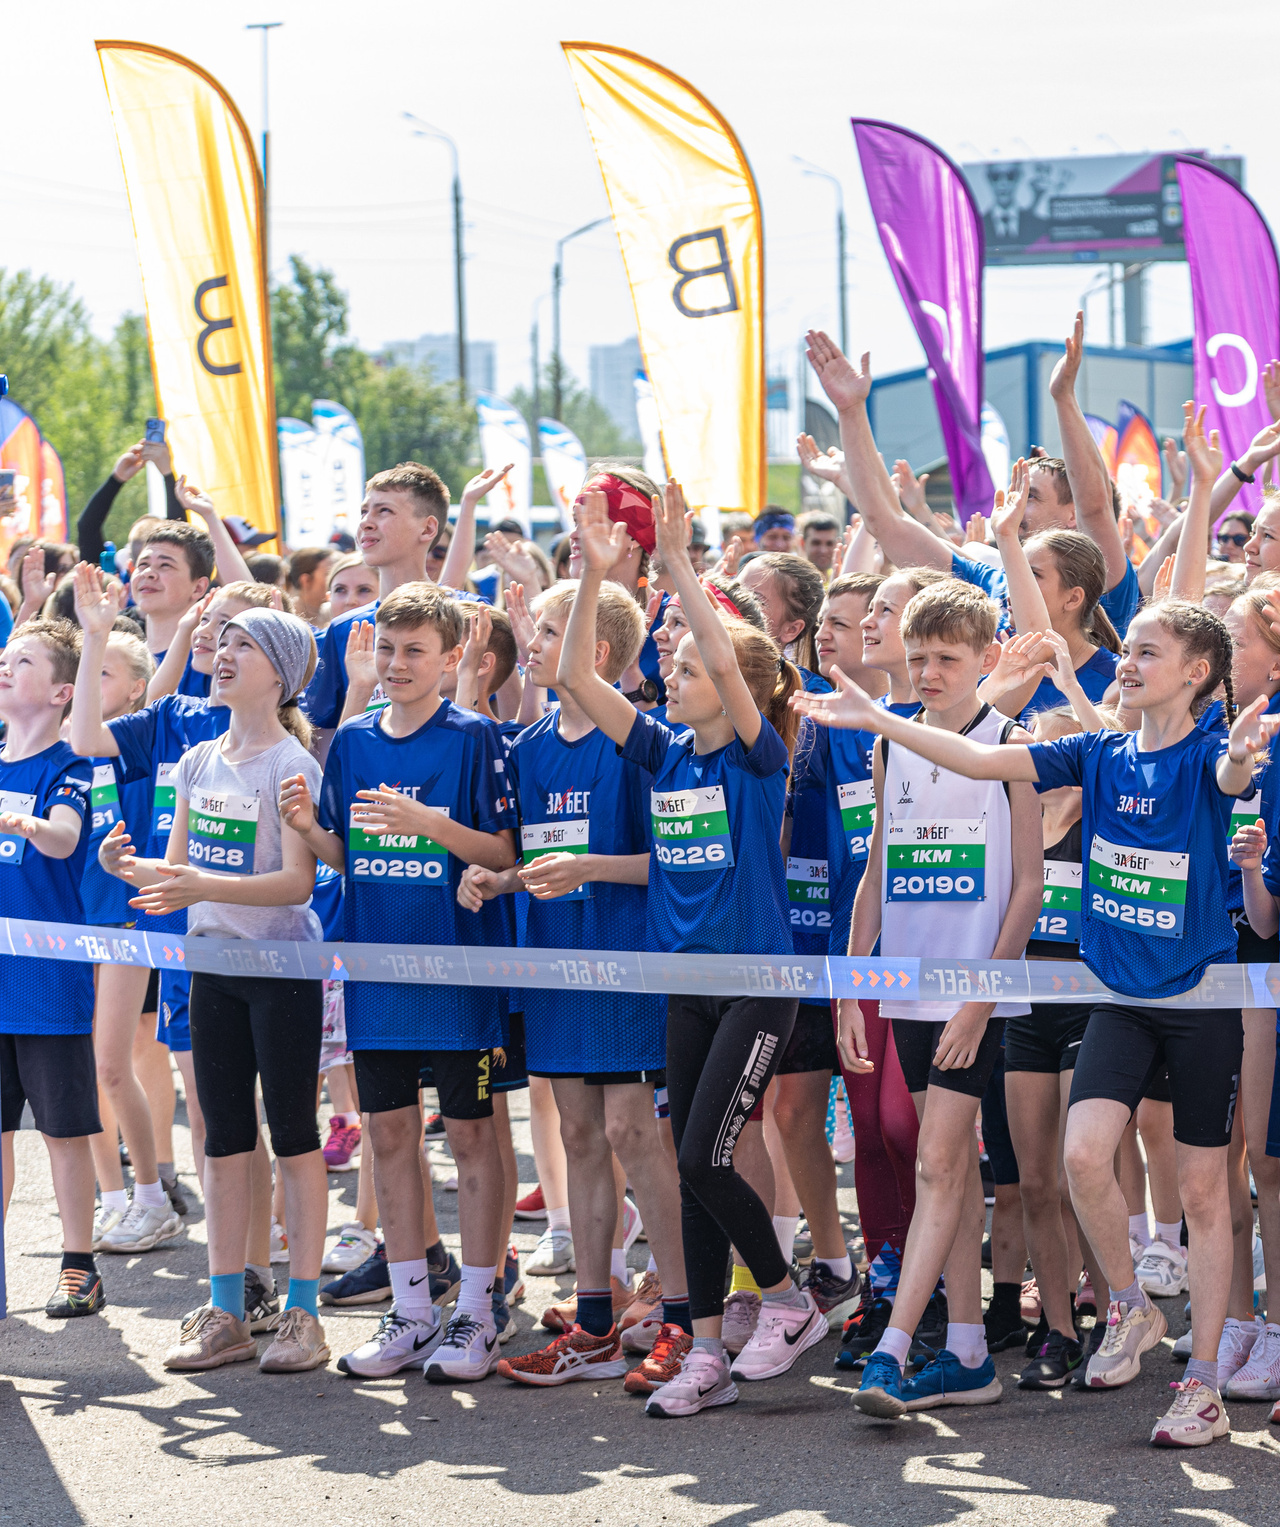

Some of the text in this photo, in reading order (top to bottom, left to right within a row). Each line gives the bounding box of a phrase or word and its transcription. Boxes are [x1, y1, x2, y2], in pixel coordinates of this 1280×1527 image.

[196, 818, 227, 836] 1KM
[658, 820, 693, 835] 1KM
[378, 833, 418, 849] 1KM
[188, 838, 245, 867] 20128
[655, 843, 726, 865] 20226
[911, 849, 952, 863] 1KM
[354, 858, 443, 880] 20290
[892, 876, 975, 894] 20190
[1110, 873, 1151, 895] 1KM
[1091, 893, 1177, 931] 20259
[748, 1033, 779, 1089] PUMA
[478, 1054, 490, 1101] FILA
